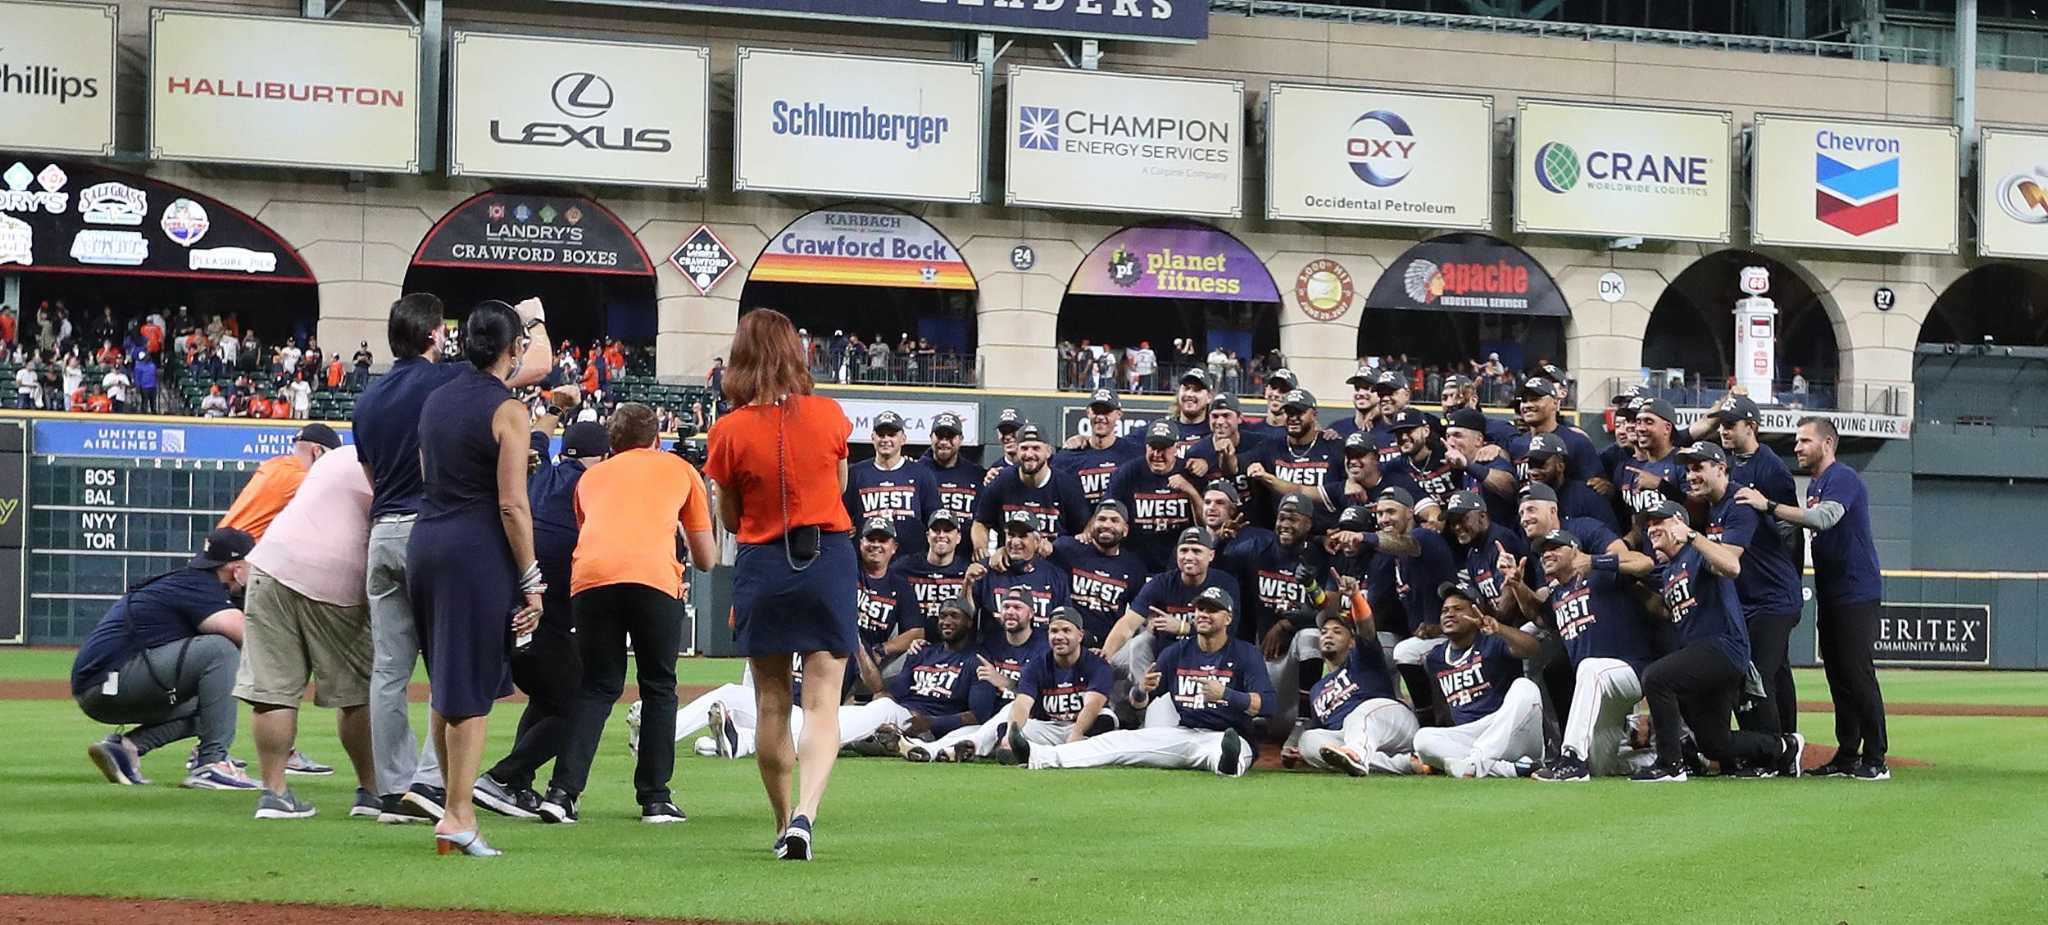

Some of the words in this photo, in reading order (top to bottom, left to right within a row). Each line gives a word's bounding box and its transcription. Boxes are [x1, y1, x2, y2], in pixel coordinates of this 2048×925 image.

[0, 64, 98, 104] hillips
[168, 76, 404, 107] HALLIBURTON
[772, 100, 948, 149] Schlumberger
[1065, 110, 1229, 143] CHAMPION
[490, 119, 672, 153] LEXUS
[1816, 130, 1900, 153] Chevron
[1065, 139, 1138, 158] ENERGY
[1142, 144, 1228, 163] SERVICES
[1347, 138, 1416, 159] OXY
[1586, 151, 1708, 186] CRANE
[1587, 182, 1650, 193] WORLDWIDE
[1655, 186, 1708, 197] LOGISTICS
[1305, 195, 1381, 210] Occidental
[1385, 199, 1456, 214] Petroleum
[824, 214, 901, 228] KARBACH
[486, 223, 584, 241] LANDRY'S
[452, 244, 555, 263] CRAWFORD
[562, 249, 618, 266] BOXES
[782, 233, 885, 259] Crawford
[892, 238, 947, 260] Bock
[1014, 248, 1031, 263] 24
[1116, 261, 1134, 279] pf
[1146, 249, 1226, 274] planet
[1157, 269, 1241, 294] fitness
[1441, 260, 1529, 295] apache
[1600, 281, 1621, 293] DK
[1877, 290, 1892, 304] 27
[98, 429, 157, 439] UNITED
[258, 434, 295, 444] UNIT
[83, 439, 157, 451] AIRLINES
[243, 444, 295, 454] AIRLIN
[154, 460, 161, 468] 2
[175, 460, 182, 469] 3
[193, 460, 201, 469] 4
[85, 469, 116, 486] BOS
[85, 489, 115, 506] BAL
[861, 491, 914, 512] WEST
[941, 493, 975, 512] EST
[1136, 499, 1188, 518] WEST
[82, 513, 117, 529] NYY
[84, 533, 116, 549] TOR
[1072, 574, 1125, 605] WEST
[1555, 594, 1590, 630] WEST
[1880, 618, 1975, 641] ERITEX
[1874, 640, 1935, 652] OMMUNITY
[1939, 642, 1968, 653] BANK
[1438, 663, 1485, 697] WEST
